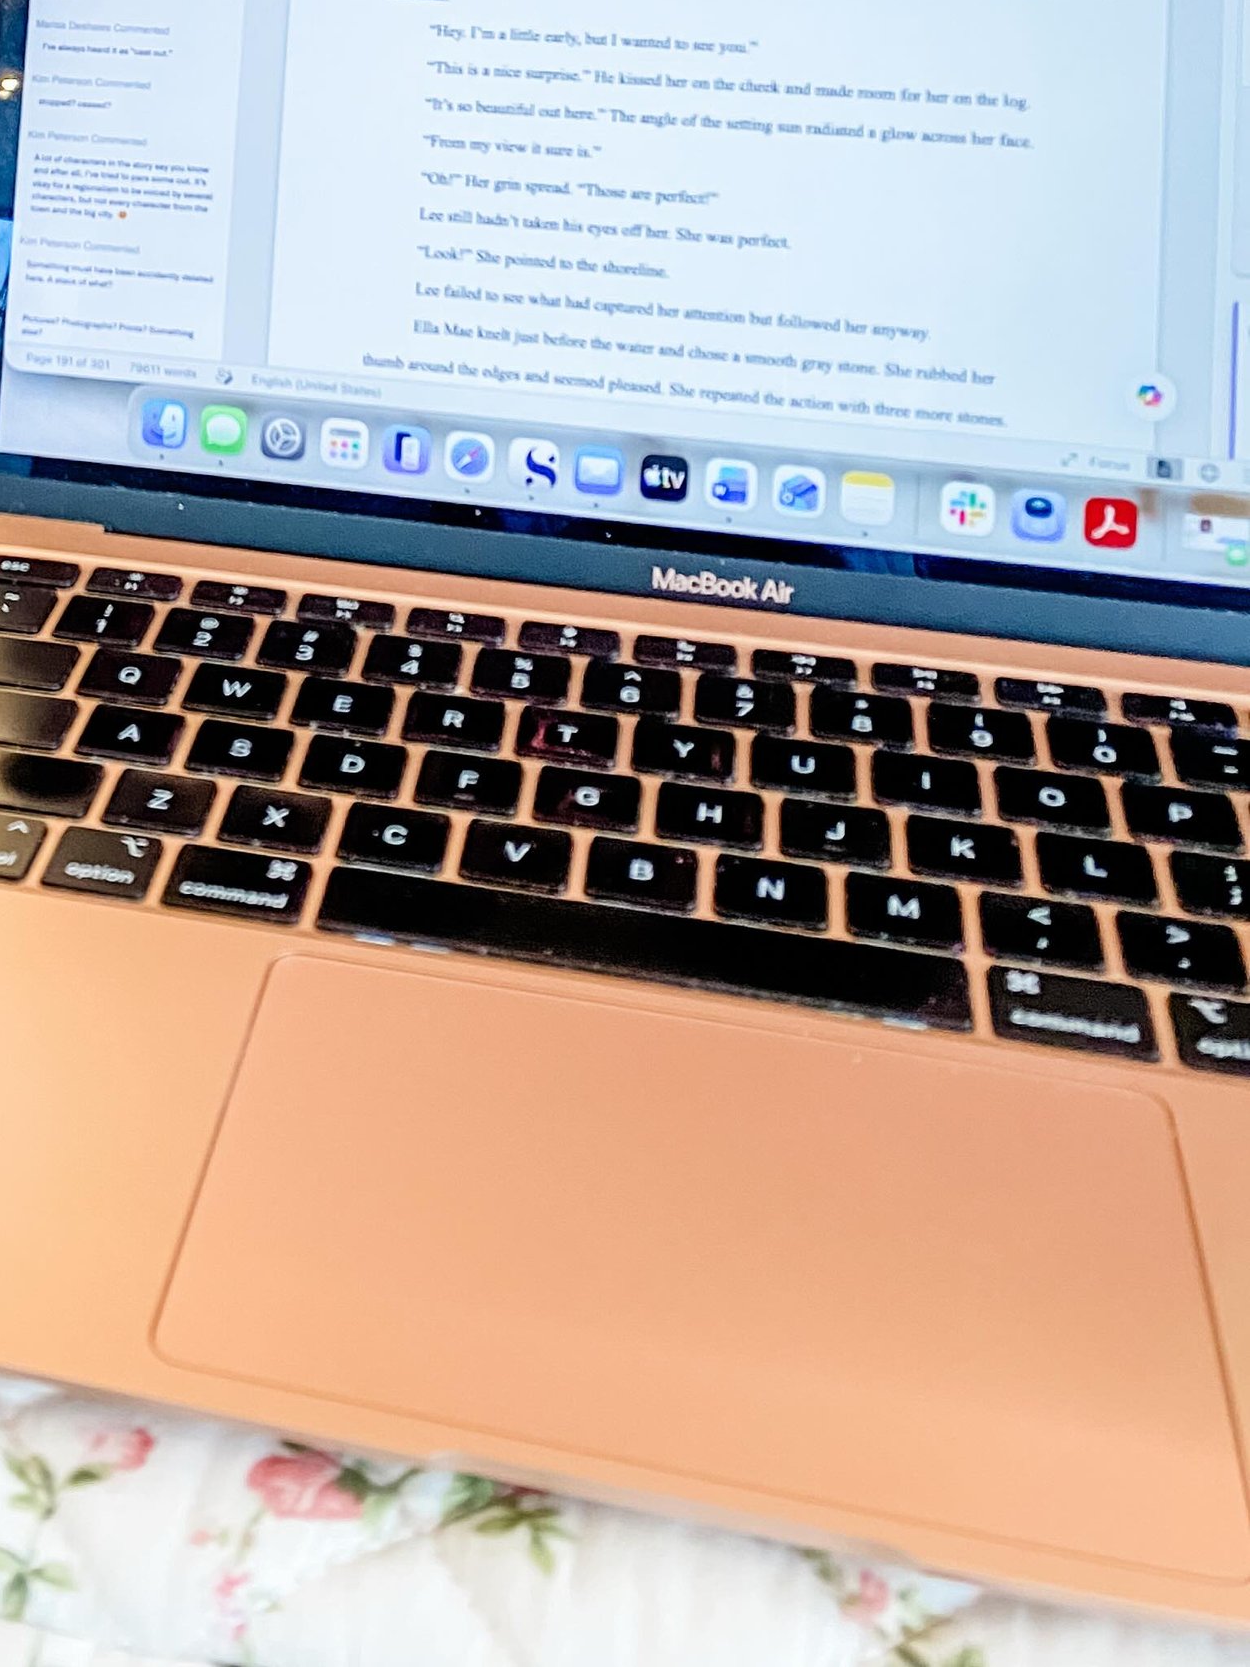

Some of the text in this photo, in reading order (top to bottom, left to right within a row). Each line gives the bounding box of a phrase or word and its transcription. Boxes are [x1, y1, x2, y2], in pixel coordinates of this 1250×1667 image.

[26, 353, 52, 366] Page
[0, 560, 30, 573] esc
[652, 567, 796, 605] MacBook Air
[117, 665, 579, 743] Q W E R T
[117, 723, 366, 774] A S D
[146, 788, 921, 921] Z M
[64, 861, 135, 885] option
[179, 879, 289, 909] command
